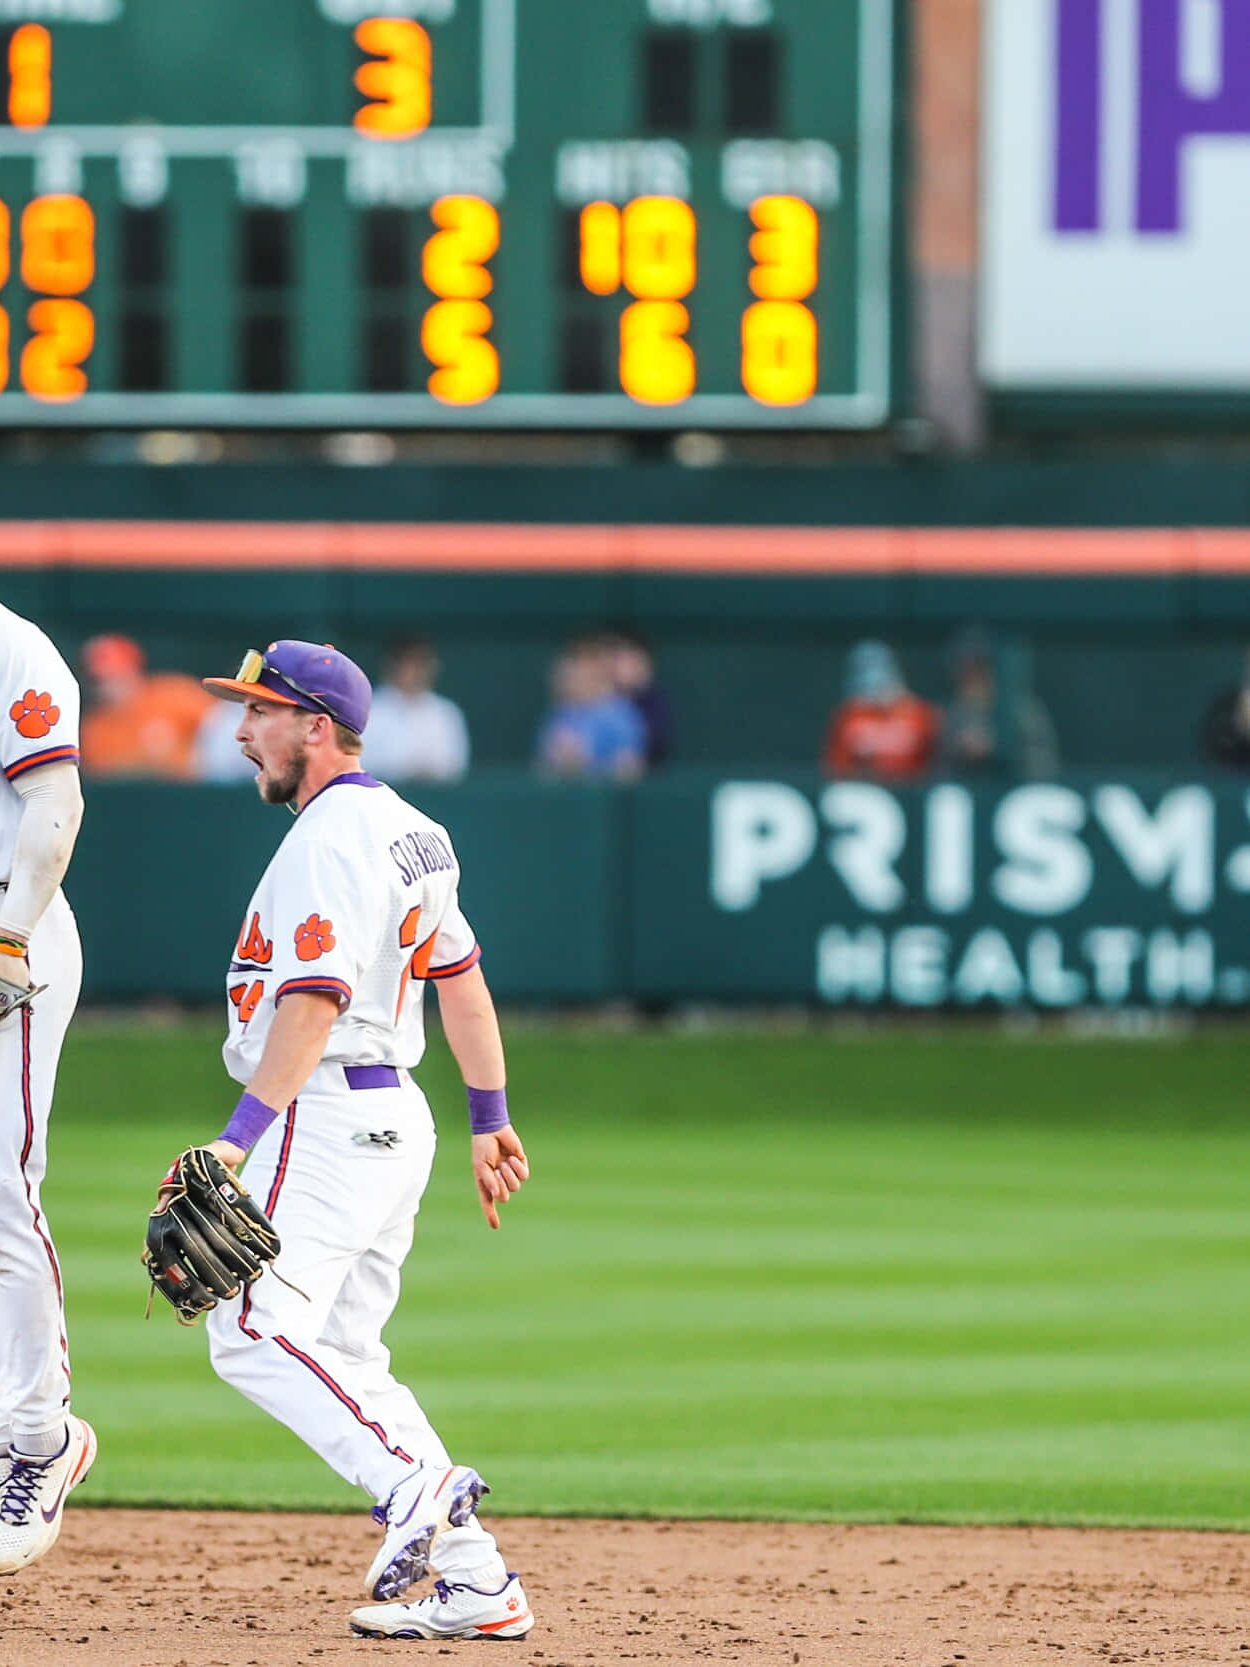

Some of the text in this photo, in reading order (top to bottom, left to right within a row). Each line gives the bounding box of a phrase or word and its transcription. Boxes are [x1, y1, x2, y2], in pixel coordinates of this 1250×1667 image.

[8, 24, 51, 131] 1
[354, 18, 432, 140] 3
[20, 193, 96, 296] 0
[421, 194, 500, 299] 2
[579, 195, 697, 299] 10
[748, 195, 819, 299] 3
[20, 298, 95, 403] 2
[420, 299, 500, 406] 5
[619, 299, 696, 406] 6
[741, 300, 818, 407] 0
